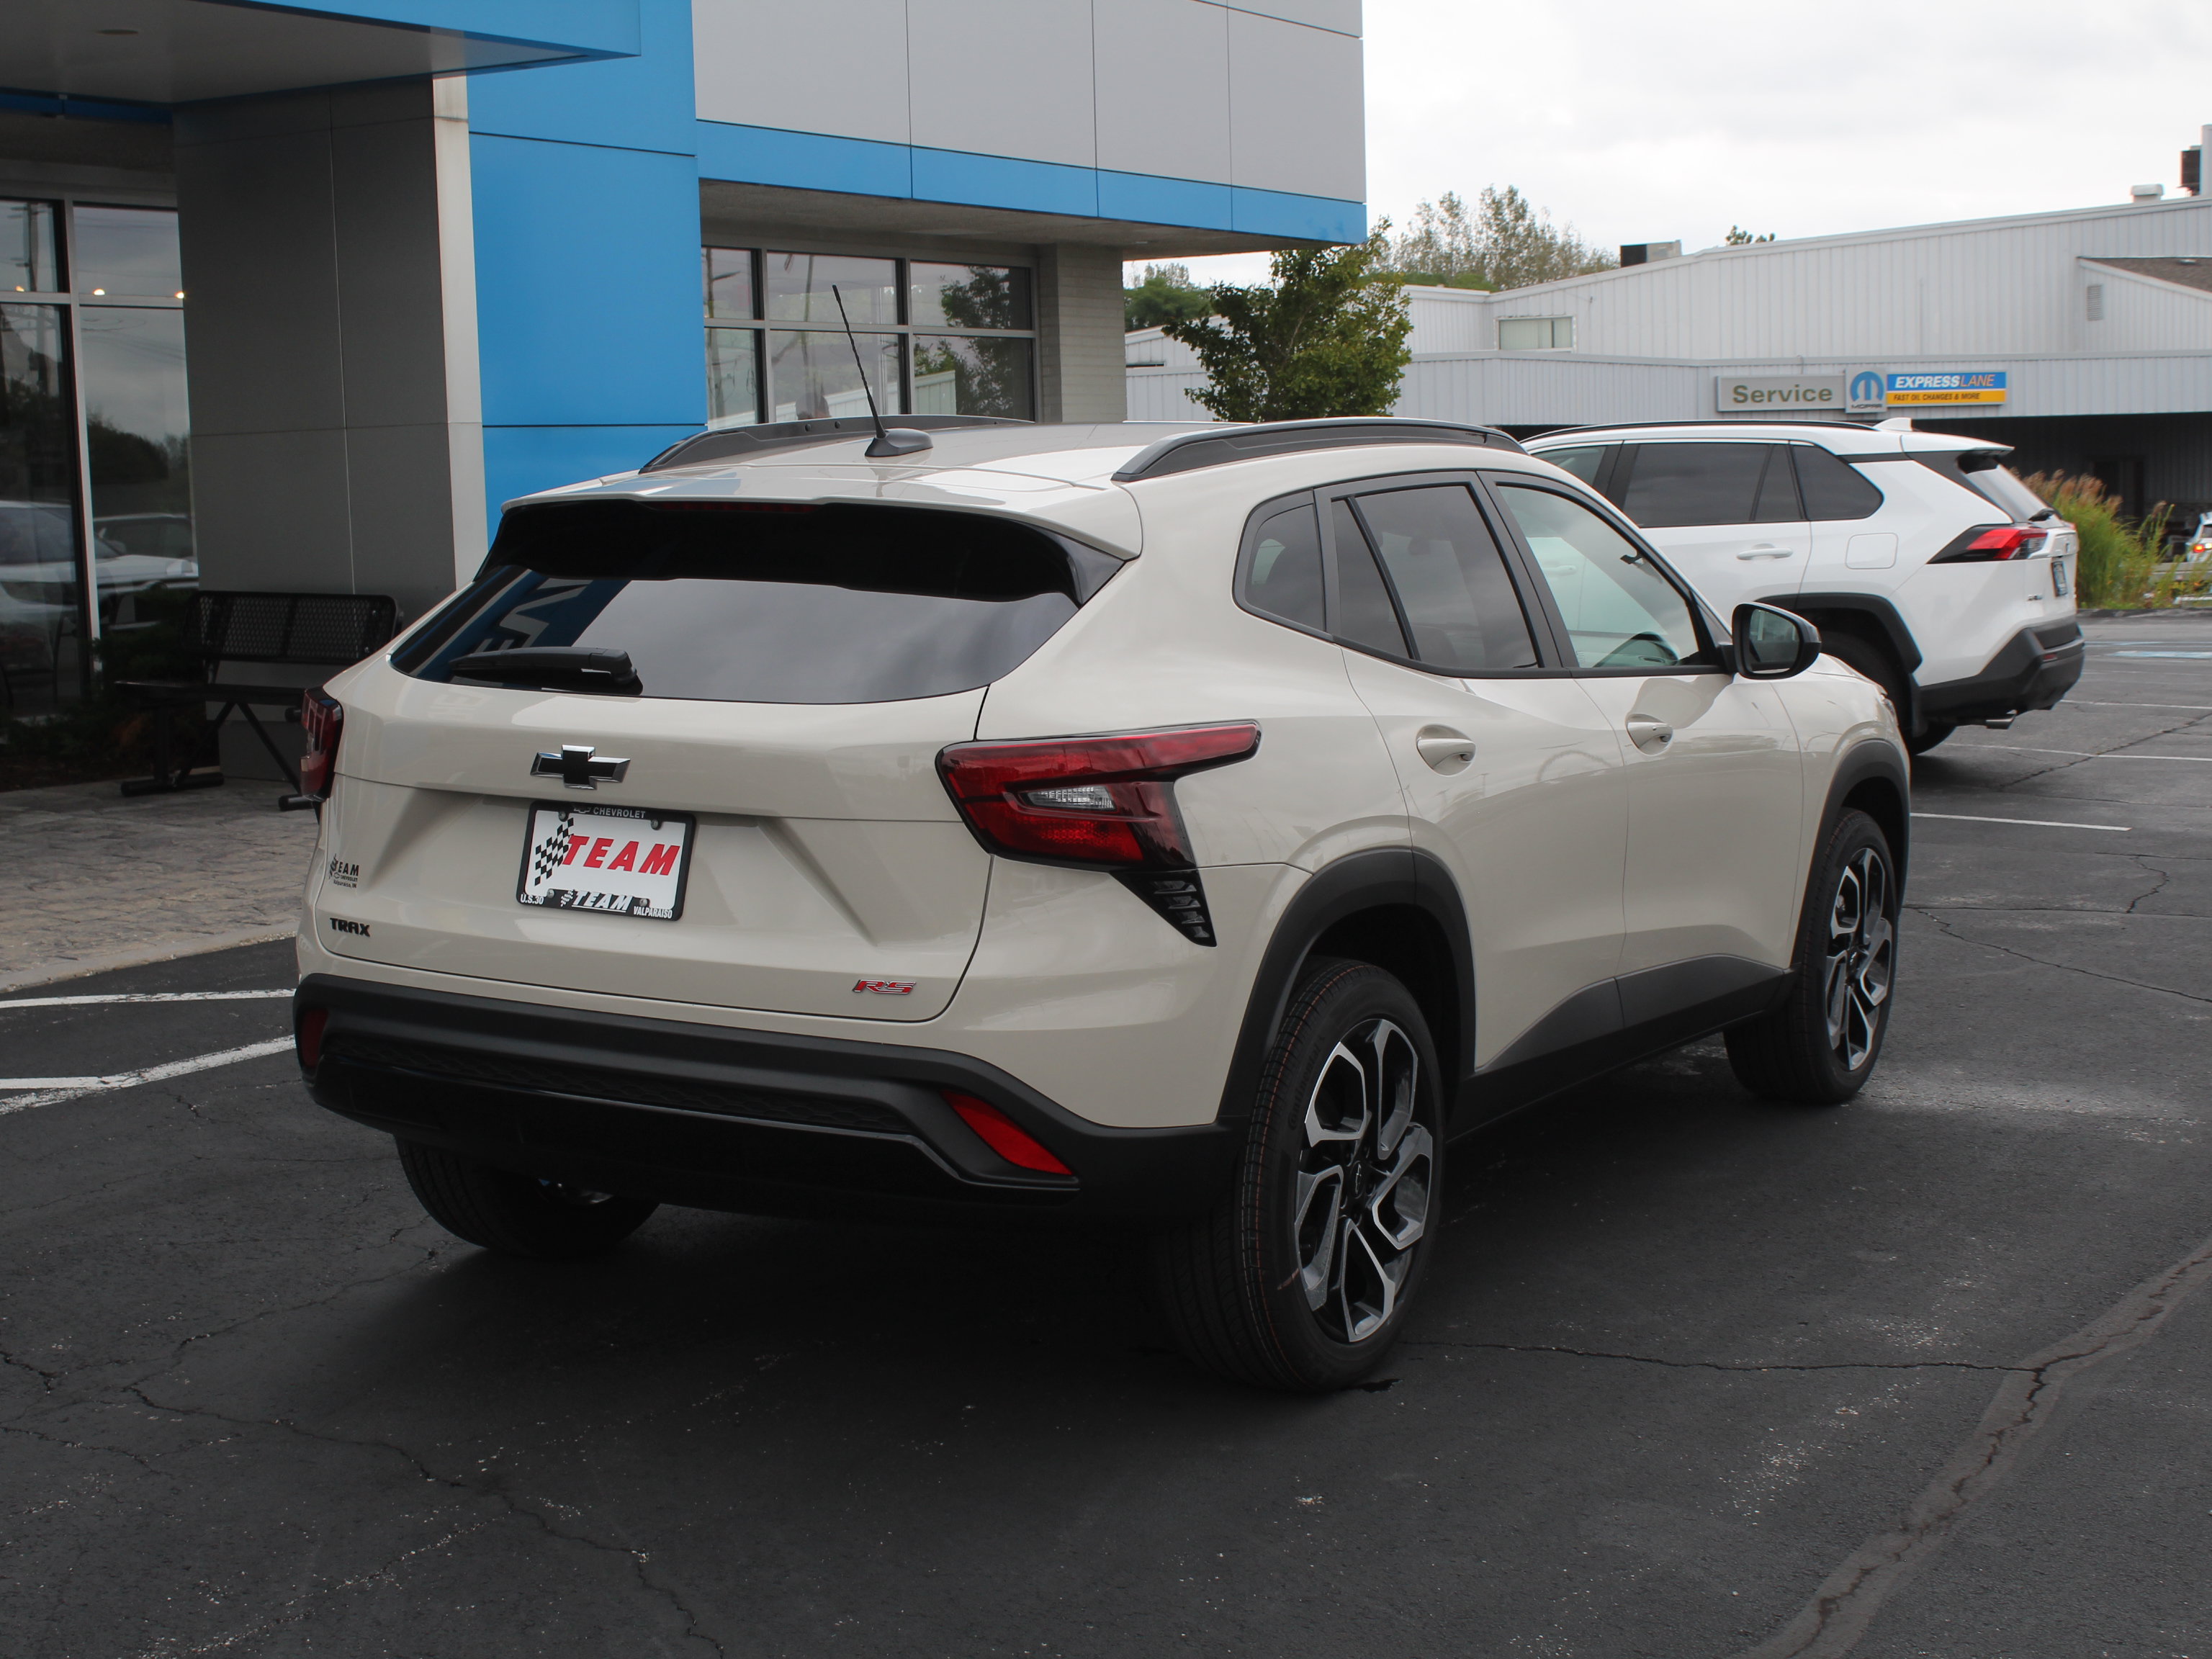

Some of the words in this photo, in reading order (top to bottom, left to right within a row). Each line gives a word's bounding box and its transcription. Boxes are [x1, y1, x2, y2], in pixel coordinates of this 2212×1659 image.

[1732, 384, 1833, 404] Service
[593, 806, 646, 819] CHEVROLET
[562, 835, 680, 876] TEAM
[333, 860, 359, 876] TEAM
[572, 890, 634, 911] TEAM
[633, 906, 673, 919] VALPARAISO
[329, 917, 371, 938] TRAX
[852, 979, 916, 994] RS
